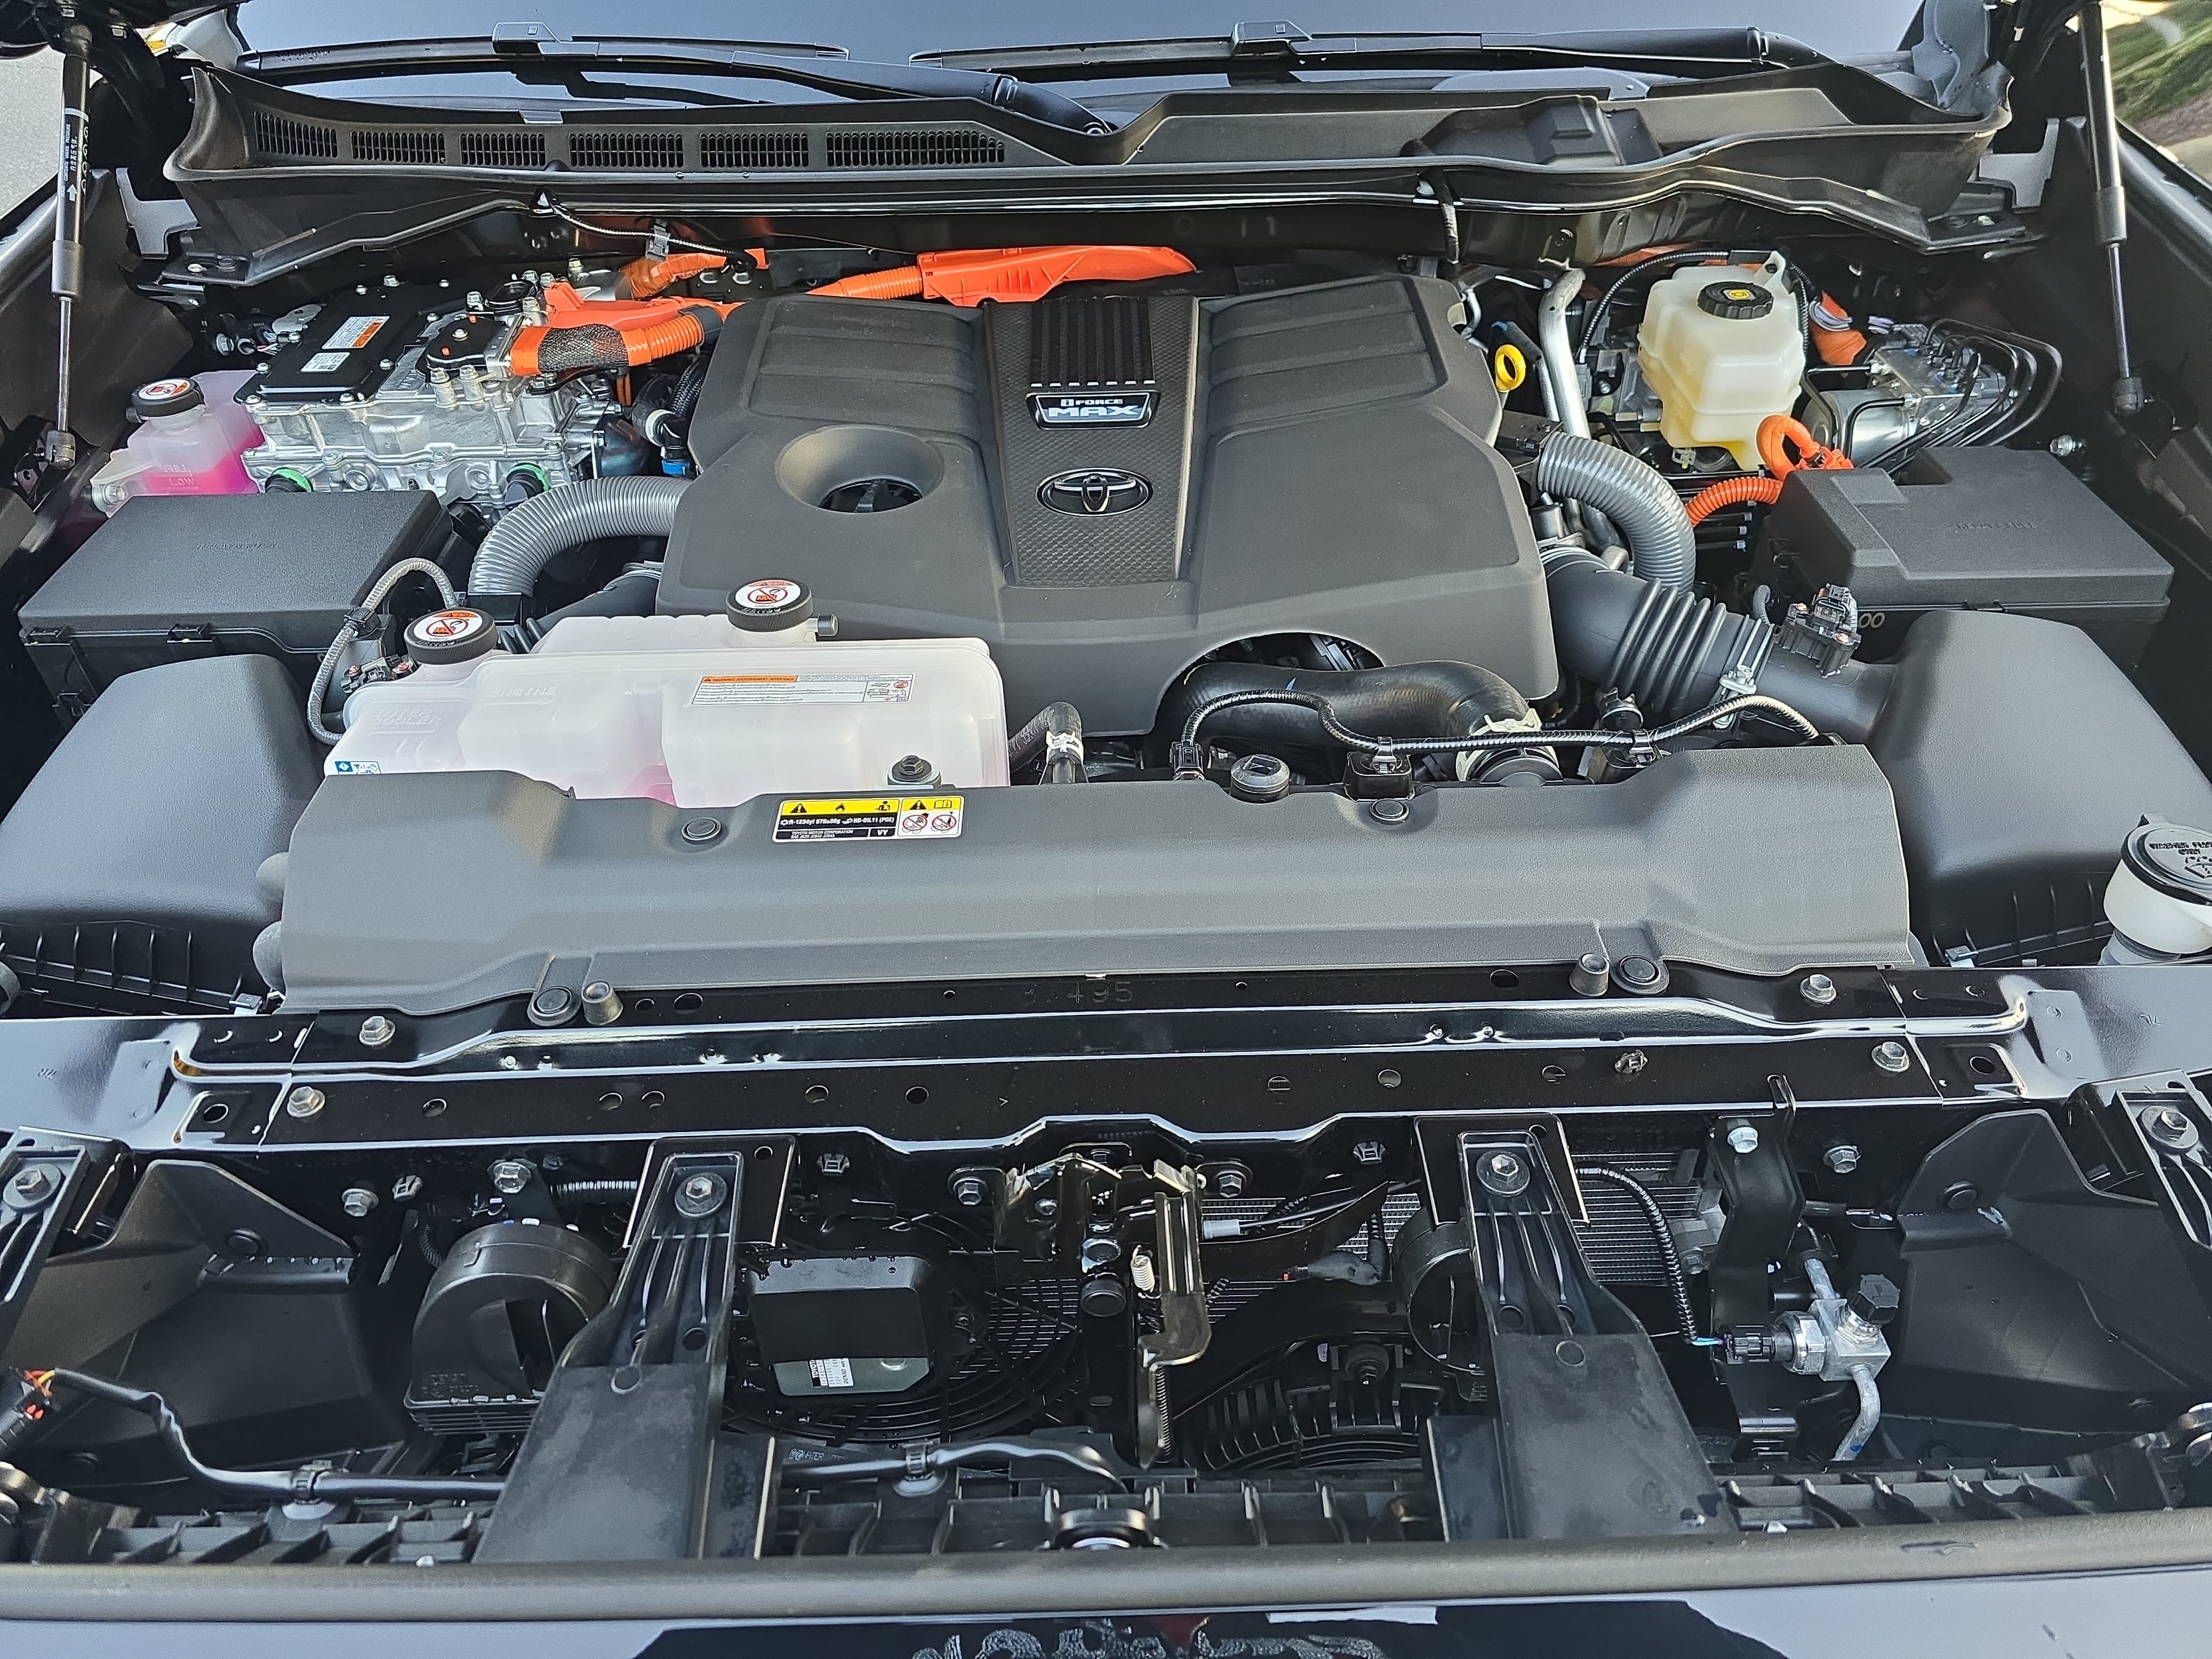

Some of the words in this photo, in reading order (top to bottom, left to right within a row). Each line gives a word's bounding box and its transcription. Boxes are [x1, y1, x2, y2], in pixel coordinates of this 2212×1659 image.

[1048, 405, 1139, 417] MAX
[163, 464, 191, 473] FULL
[169, 477, 194, 486] LOW
[488, 686, 558, 697] ENGINE
[841, 1369, 849, 1384] DENSO
